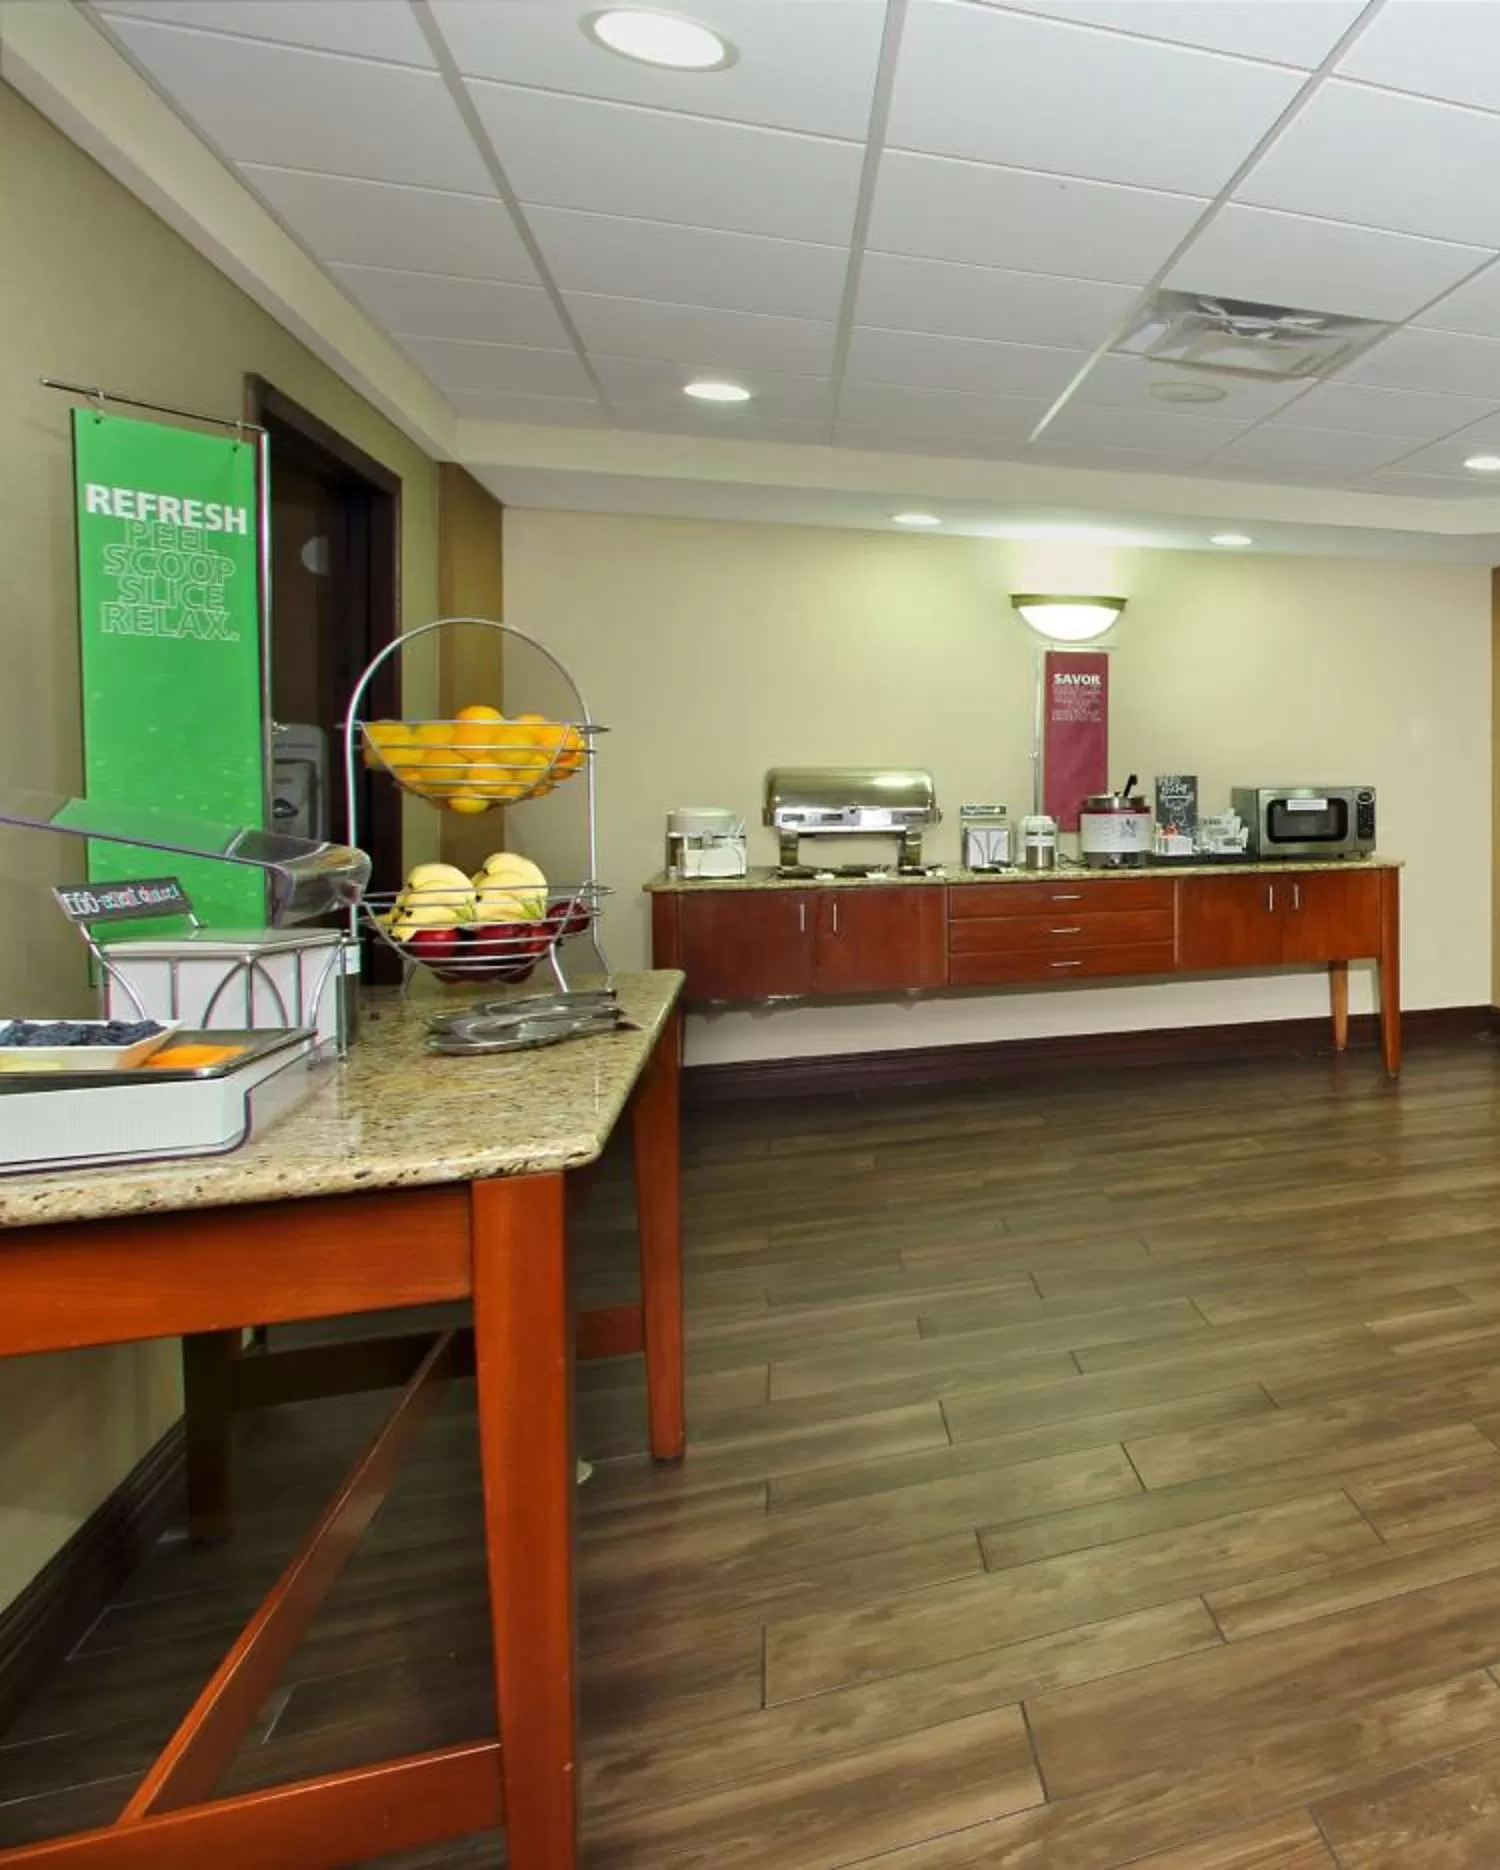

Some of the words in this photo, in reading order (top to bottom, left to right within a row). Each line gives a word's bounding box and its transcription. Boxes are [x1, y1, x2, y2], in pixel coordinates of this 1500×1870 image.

[86, 483, 247, 535] REFRESH
[103, 543, 236, 586] SCOOP
[118, 575, 225, 613] SLICE
[101, 601, 241, 641] RELAX.
[1053, 673, 1101, 685] SAVOR
